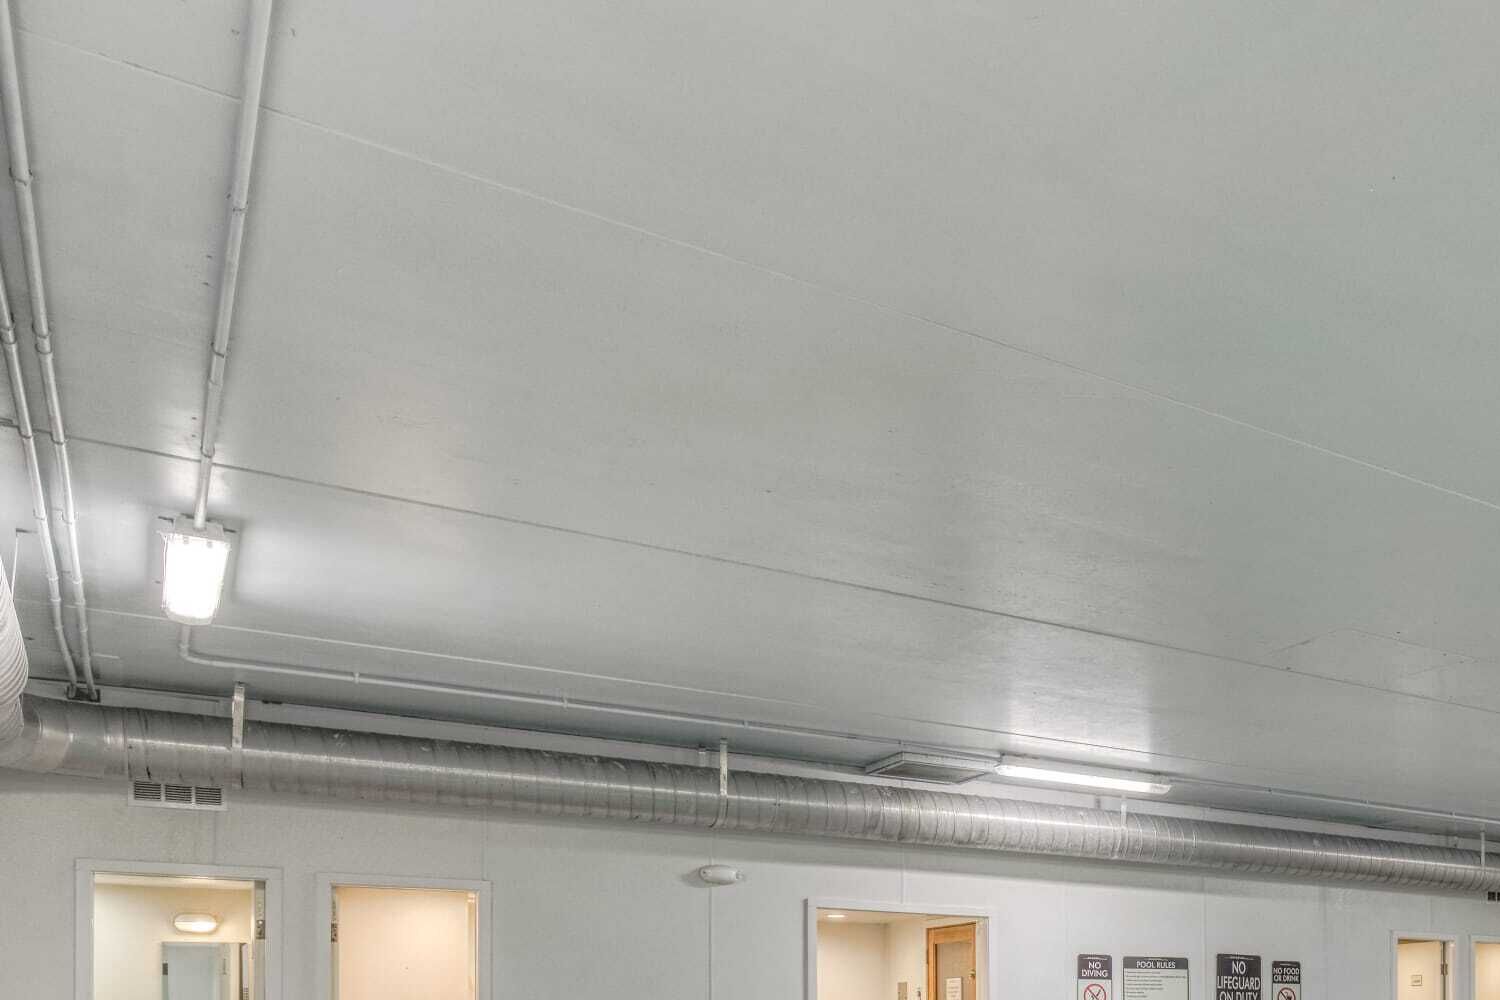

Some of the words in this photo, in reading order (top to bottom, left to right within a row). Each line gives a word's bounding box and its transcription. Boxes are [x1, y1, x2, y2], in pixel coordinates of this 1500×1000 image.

[1088, 961, 1102, 969] NO
[1136, 960, 1156, 969] POOL
[1156, 961, 1176, 969] RULES
[1231, 960, 1247, 975] NO
[1081, 969, 1109, 977] DIVING
[1273, 967, 1283, 975] NO
[1283, 967, 1300, 975] FOOD
[1217, 975, 1261, 990] LIFEGUARD
